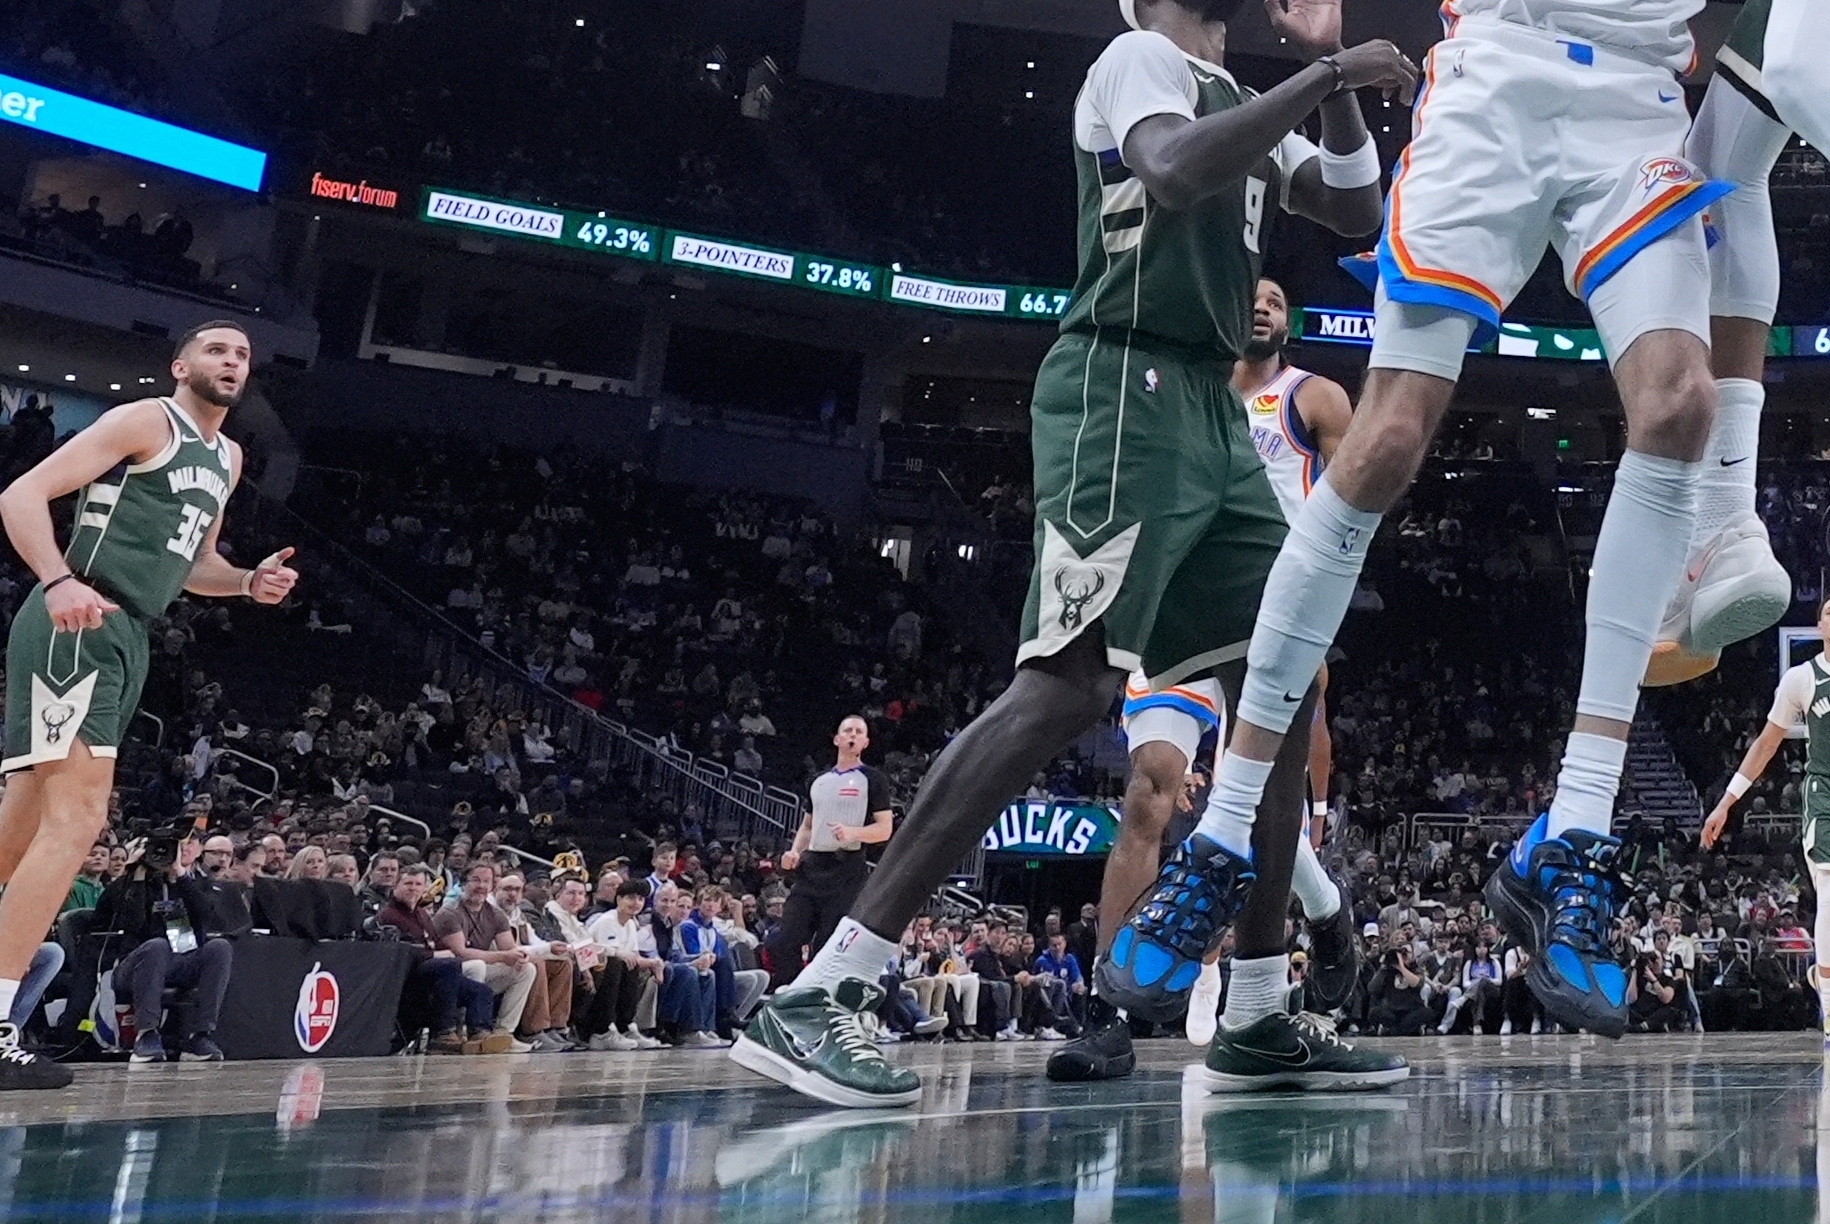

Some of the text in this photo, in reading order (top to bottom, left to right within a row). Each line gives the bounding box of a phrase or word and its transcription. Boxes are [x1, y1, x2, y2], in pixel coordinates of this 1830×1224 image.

[433, 197, 650, 253] FIELD GOALS 49.3%
[1243, 175, 1268, 255] 9
[677, 240, 872, 292] 3-POINTERS 37.8%
[895, 280, 932, 299] FREE
[935, 286, 1001, 307] THROWS
[166, 502, 213, 563] 35
